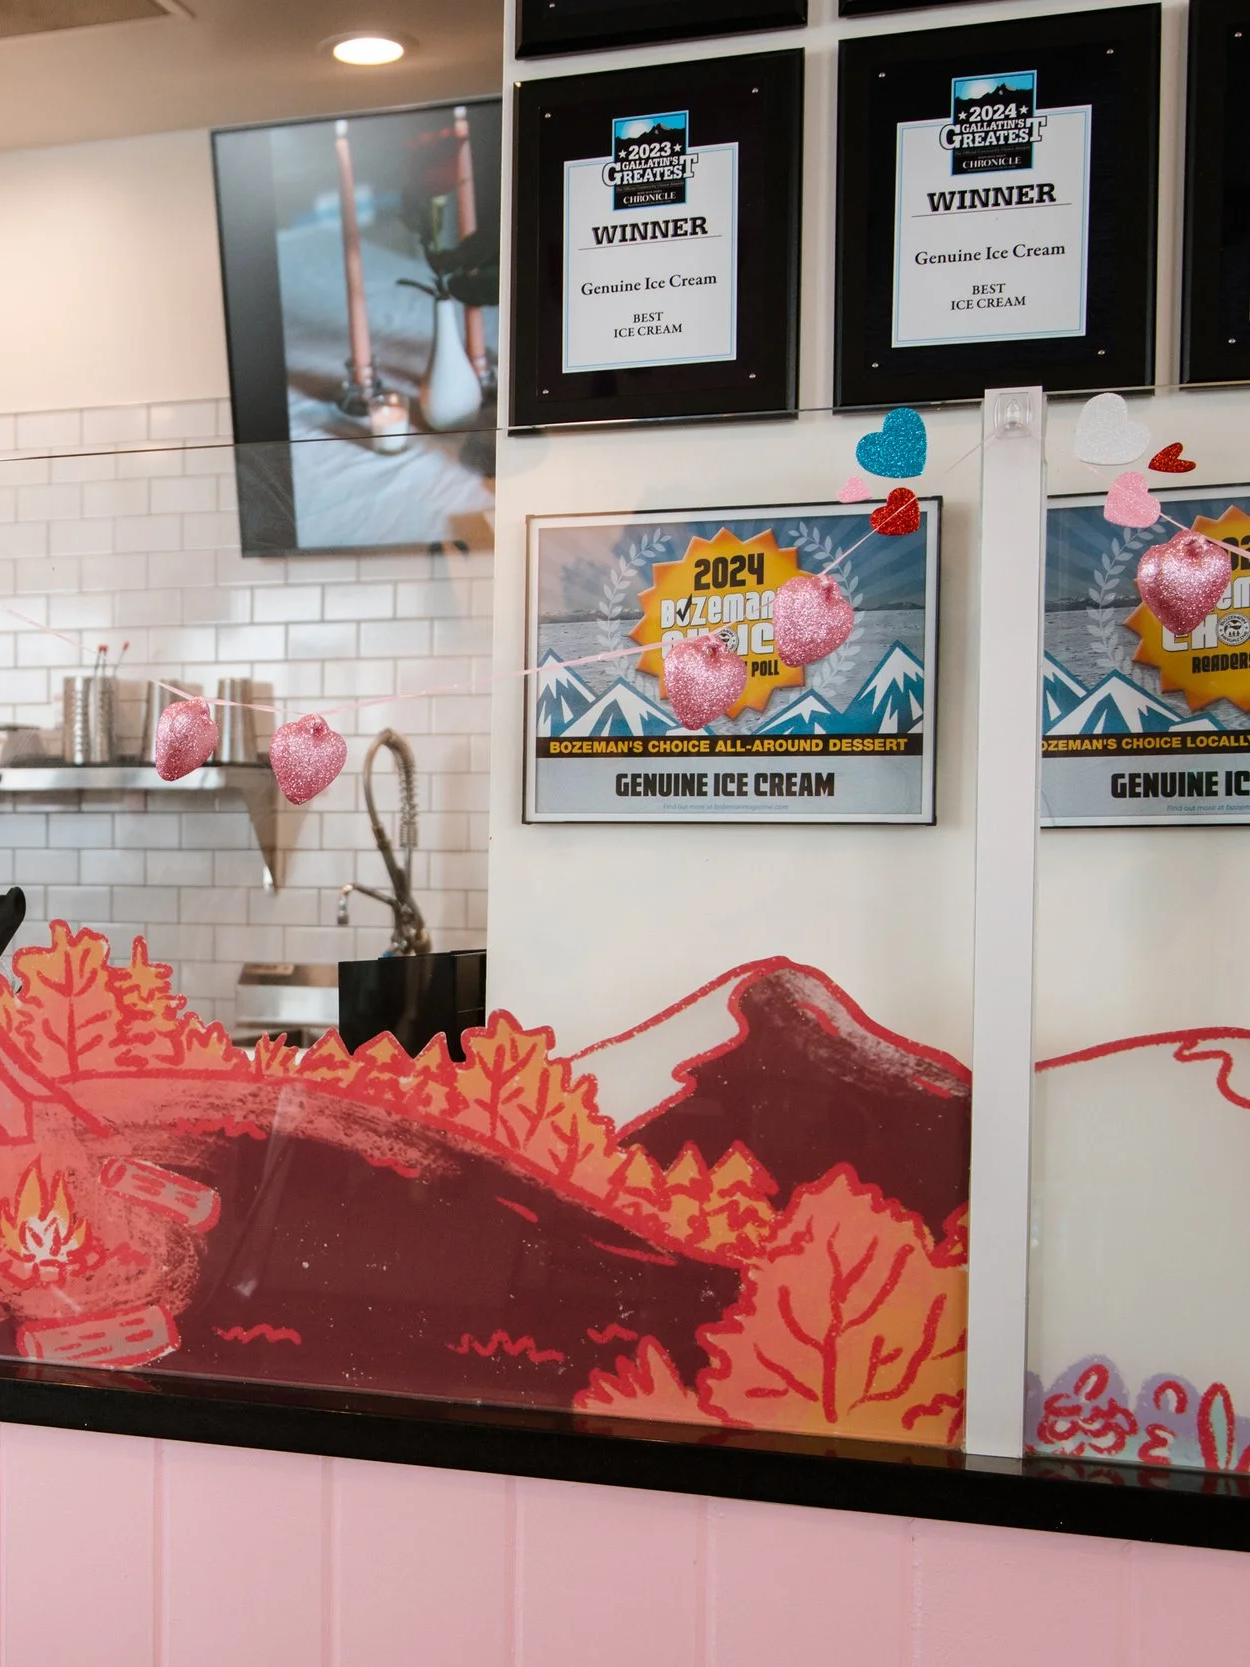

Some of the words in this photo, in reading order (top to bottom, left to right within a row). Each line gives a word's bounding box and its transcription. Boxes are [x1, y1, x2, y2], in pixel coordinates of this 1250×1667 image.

[969, 103, 1017, 122] 2024
[939, 116, 1047, 150] GREATEST
[961, 119, 1025, 133] GALLATIN'S
[628, 141, 672, 160] 2023
[602, 153, 699, 187] GREATEST
[621, 156, 678, 171] GALLATIN'S
[962, 156, 1022, 169] CHRONICLE
[623, 191, 677, 204] CHRONICLE
[927, 183, 1057, 213] WINNER
[592, 216, 708, 245] WINNER
[914, 249, 981, 265] Genuine
[986, 247, 1008, 260] Ice
[1013, 244, 1066, 258] Cream
[581, 280, 641, 296] Genuine
[645, 277, 665, 290] Ice
[669, 274, 717, 288] Cream
[972, 283, 1006, 295] BEST
[950, 299, 974, 311] ICE
[976, 296, 1026, 309] CREAM
[633, 311, 664, 323] BEST
[614, 327, 635, 339] ICE
[637, 323, 682, 337] CREAM
[694, 553, 764, 591] 2024
[751, 659, 780, 677] POLL
[549, 741, 643, 753] BOZEMAN'S
[648, 740, 710, 753] CHOICE
[715, 739, 823, 752] ALL-AROUND
[829, 738, 908, 751] DESSERT
[1041, 738, 1117, 751] OZEMAN'S
[1121, 737, 1182, 749] CHOICE
[616, 773, 708, 797] GENUINE
[713, 772, 749, 797] ICE
[753, 772, 835, 797] CREAM
[1111, 771, 1219, 798] GENUINE
[1225, 771, 1250, 796] IC
